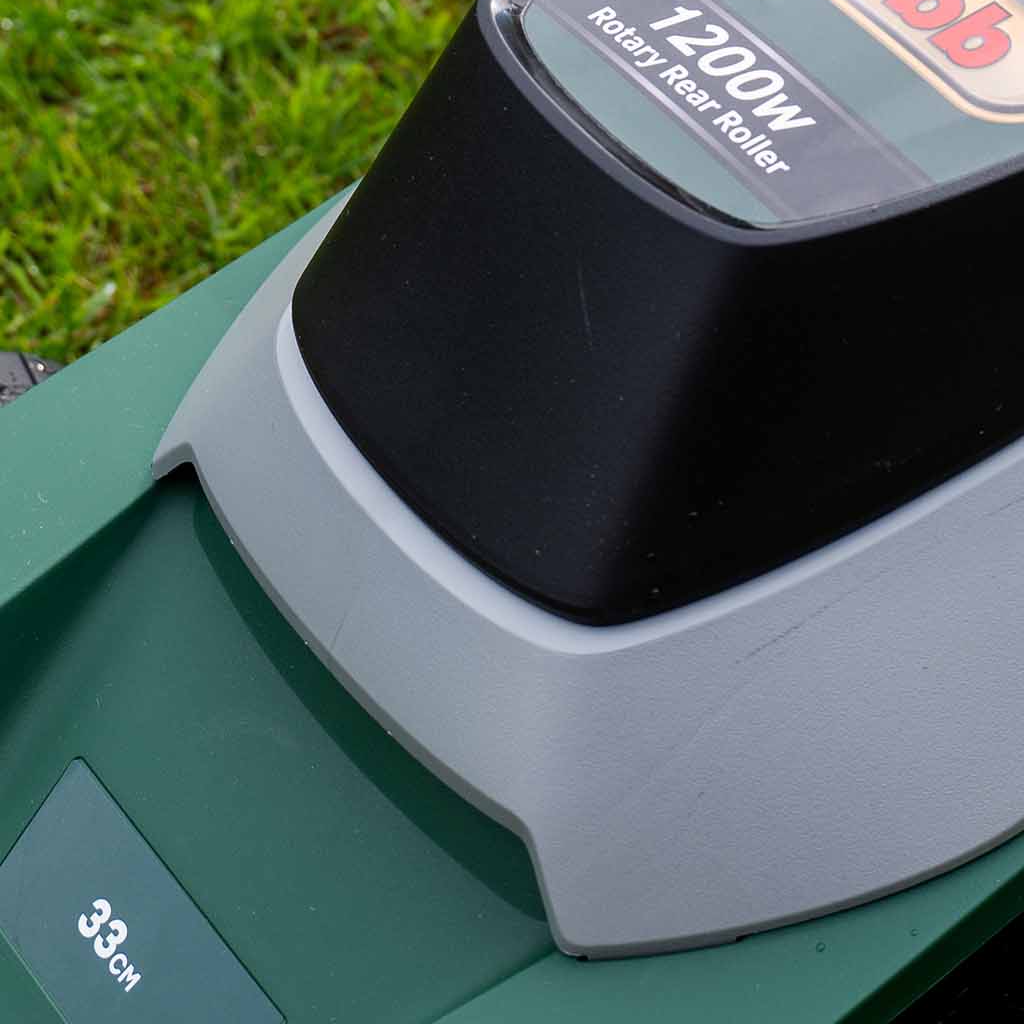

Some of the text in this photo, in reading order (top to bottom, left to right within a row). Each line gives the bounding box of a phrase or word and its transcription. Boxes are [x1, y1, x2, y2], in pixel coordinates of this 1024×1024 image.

[587, 6, 790, 174] Rotary Rear Roller
